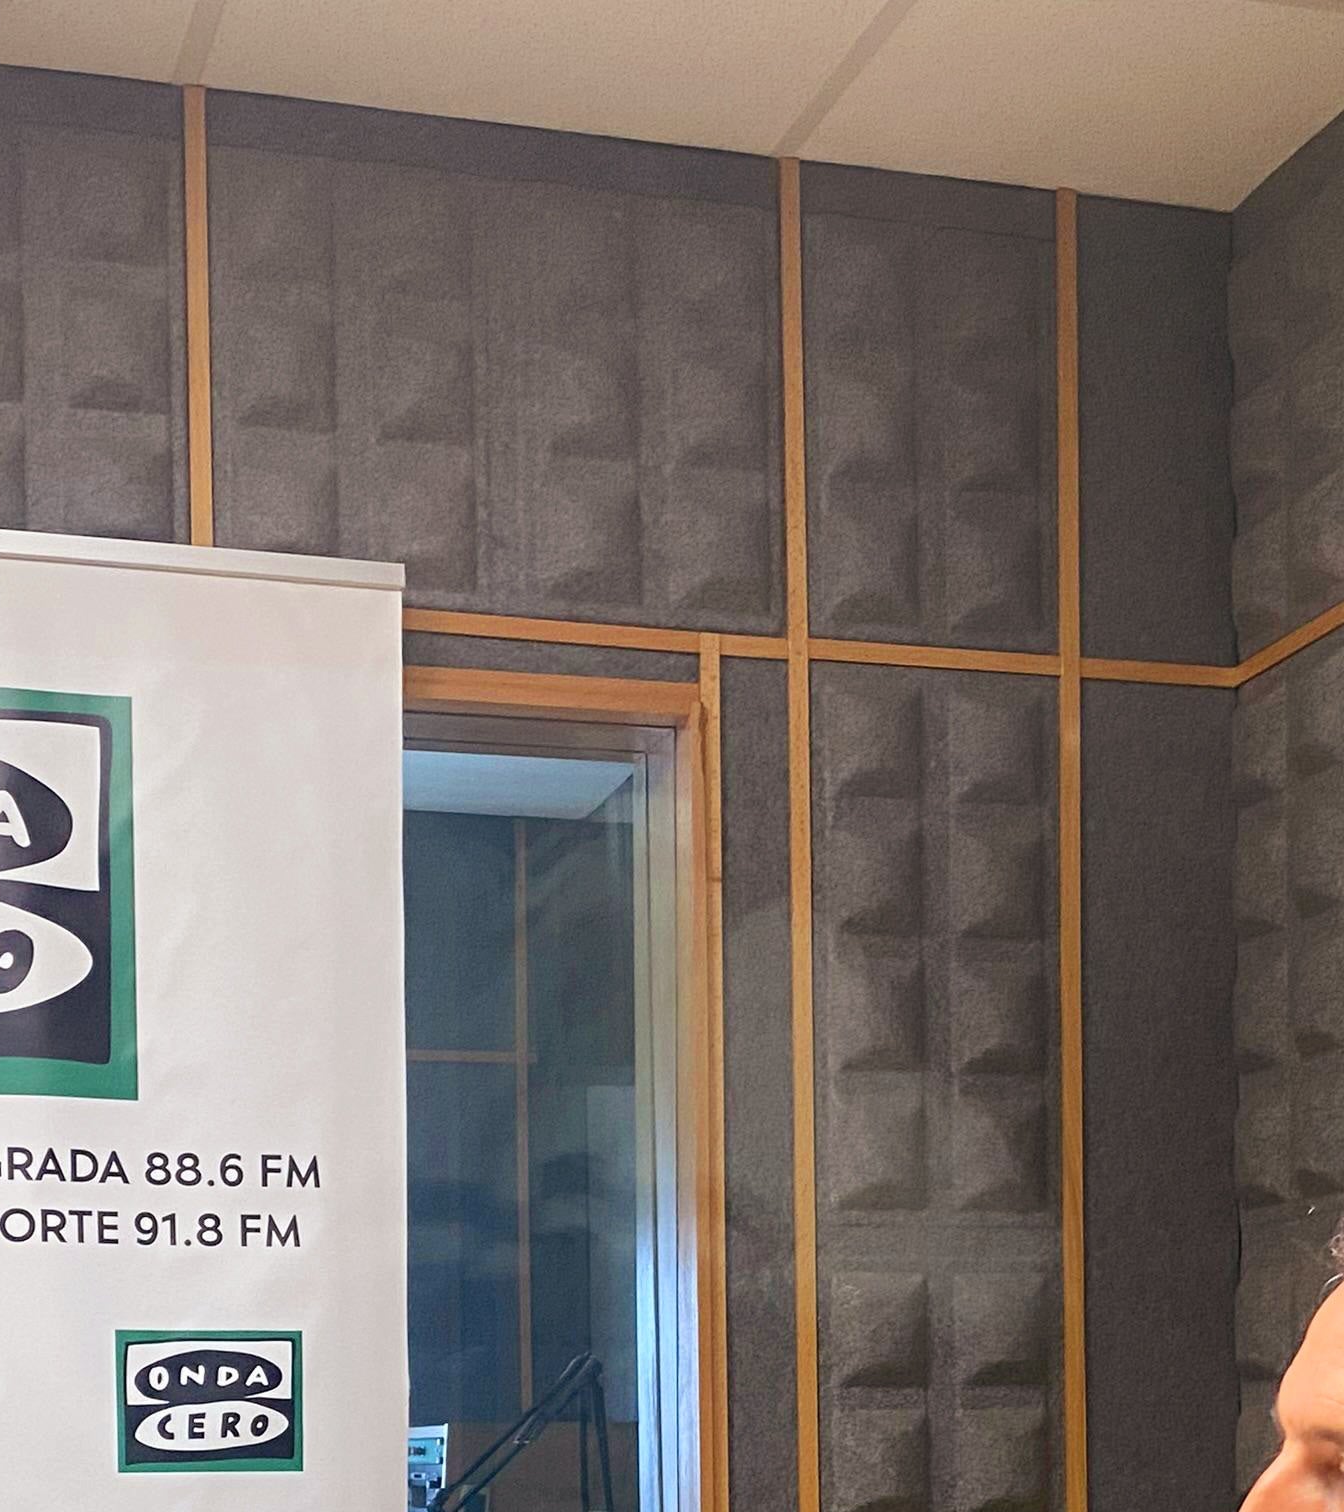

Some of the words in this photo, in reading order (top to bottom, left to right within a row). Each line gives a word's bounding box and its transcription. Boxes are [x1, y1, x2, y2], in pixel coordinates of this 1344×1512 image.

[145, 1152, 244, 1187] 88.6
[261, 1154, 321, 1188] FM
[135, 1211, 223, 1247] 91.8
[240, 1214, 301, 1248] FM
[149, 1365, 269, 1391] ONDA
[157, 1412, 269, 1440] CERO
